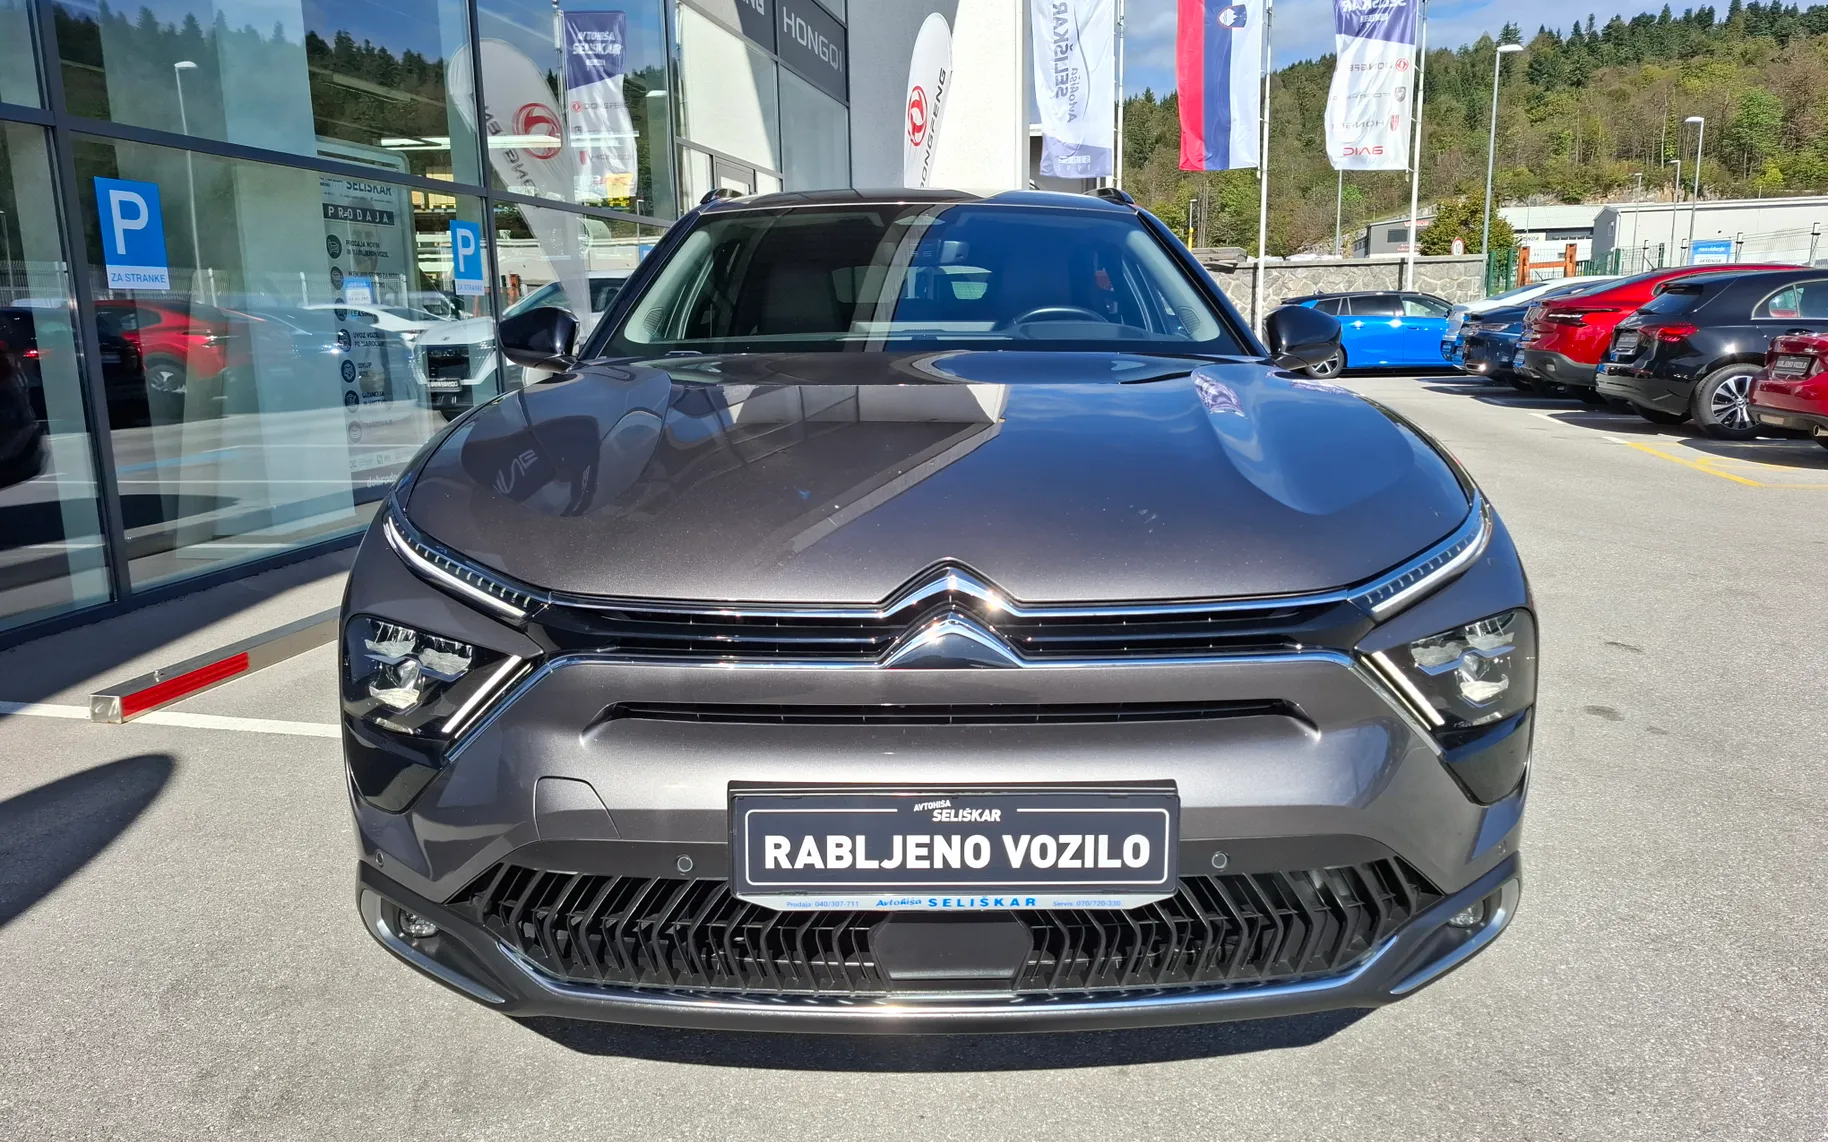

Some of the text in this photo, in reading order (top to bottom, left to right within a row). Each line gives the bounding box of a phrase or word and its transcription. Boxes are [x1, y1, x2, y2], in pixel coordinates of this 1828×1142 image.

[783, 6, 843, 73] HONGQI
[109, 190, 149, 255] P
[328, 206, 389, 223] PRODAJA
[456, 228, 476, 273] P
[111, 273, 166, 283] ZA STRANKE
[913, 800, 951, 812] AVTOHIŠA
[932, 808, 1001, 822] SELIŠKAR
[764, 834, 1151, 870] RABLJENO VOZILO
[928, 896, 1037, 907] SELIŠKAR
